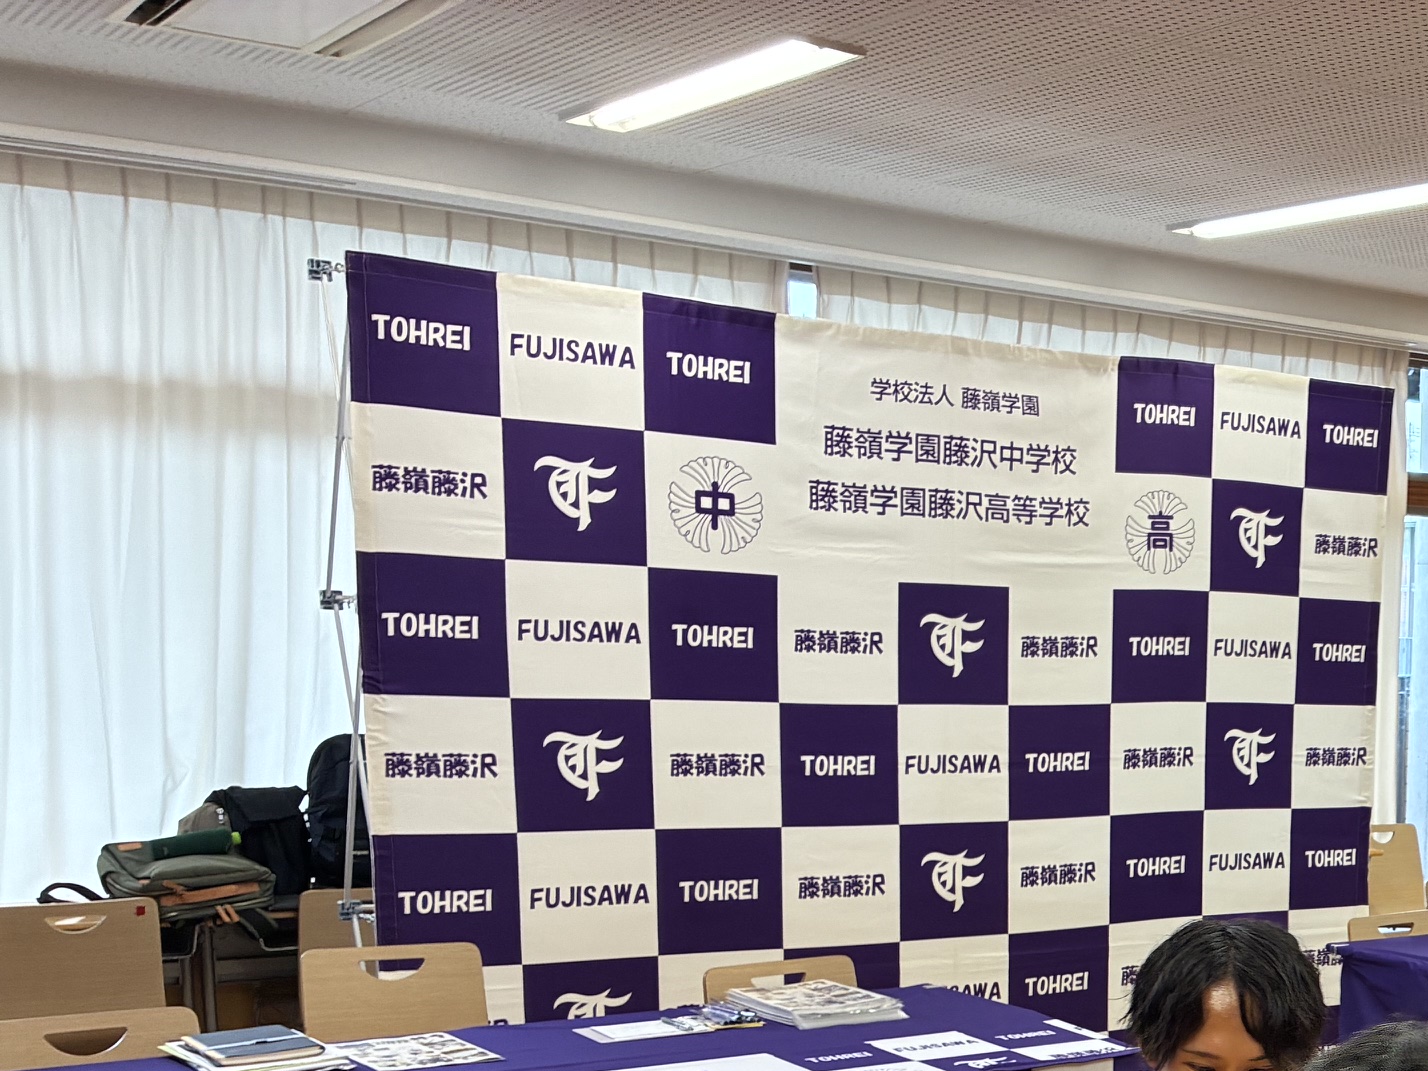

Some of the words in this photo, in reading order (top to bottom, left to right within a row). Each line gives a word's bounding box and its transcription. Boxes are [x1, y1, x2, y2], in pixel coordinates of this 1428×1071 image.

[371, 313, 471, 351] TOHREI
[509, 333, 636, 370] FUJISAWA
[666, 351, 751, 385] TOHREI
[870, 377, 955, 408] 学校法人
[961, 386, 1040, 417] 藤嶺学園
[1133, 402, 1196, 427] TOHREI
[1220, 411, 1301, 440] FUJISAWA
[1322, 423, 1379, 448] TOHREI
[823, 424, 1077, 476] 藤嶺学園藤沢中学校
[371, 464, 488, 500] 藤嶺藤沢
[692, 480, 737, 531] 中
[808, 479, 1090, 528] 藤嶺学園藤沢高等学校
[1145, 510, 1175, 553] 高
[1314, 533, 1378, 558] 藤嶺藤沢
[381, 612, 479, 640] TOHREI
[517, 618, 642, 645] FUJISAWA
[671, 623, 754, 649] TOHREI
[794, 628, 884, 655] 藤嶺藤沢
[1020, 635, 1098, 659] 藤嶺藤沢
[1128, 636, 1191, 657] TOHREI
[1213, 638, 1292, 660] FUJISAWA
[1312, 642, 1367, 663] TOHREI
[383, 751, 498, 779] 藤嶺藤沢
[669, 752, 766, 778] 藤嶺藤沢
[800, 754, 876, 777] TOHREI
[904, 754, 1002, 775] FUJISAWA
[1024, 750, 1091, 773] TOHREI
[1122, 746, 1194, 770] 藤嶺藤沢
[1304, 746, 1367, 767] 藤嶺藤沢
[1125, 854, 1186, 878] TOHREI
[1208, 851, 1286, 872] FUJISAWA
[1304, 848, 1357, 868] TOHREI
[798, 873, 886, 900] 藤嶺藤沢
[1020, 861, 1096, 888] 藤嶺藤沢
[397, 888, 493, 915] TOHREI
[529, 883, 650, 910] FUJISAWA
[678, 878, 759, 903] TOHREI
[1024, 971, 1089, 997] TOHREI
[804, 1051, 873, 1063] TOHREI
